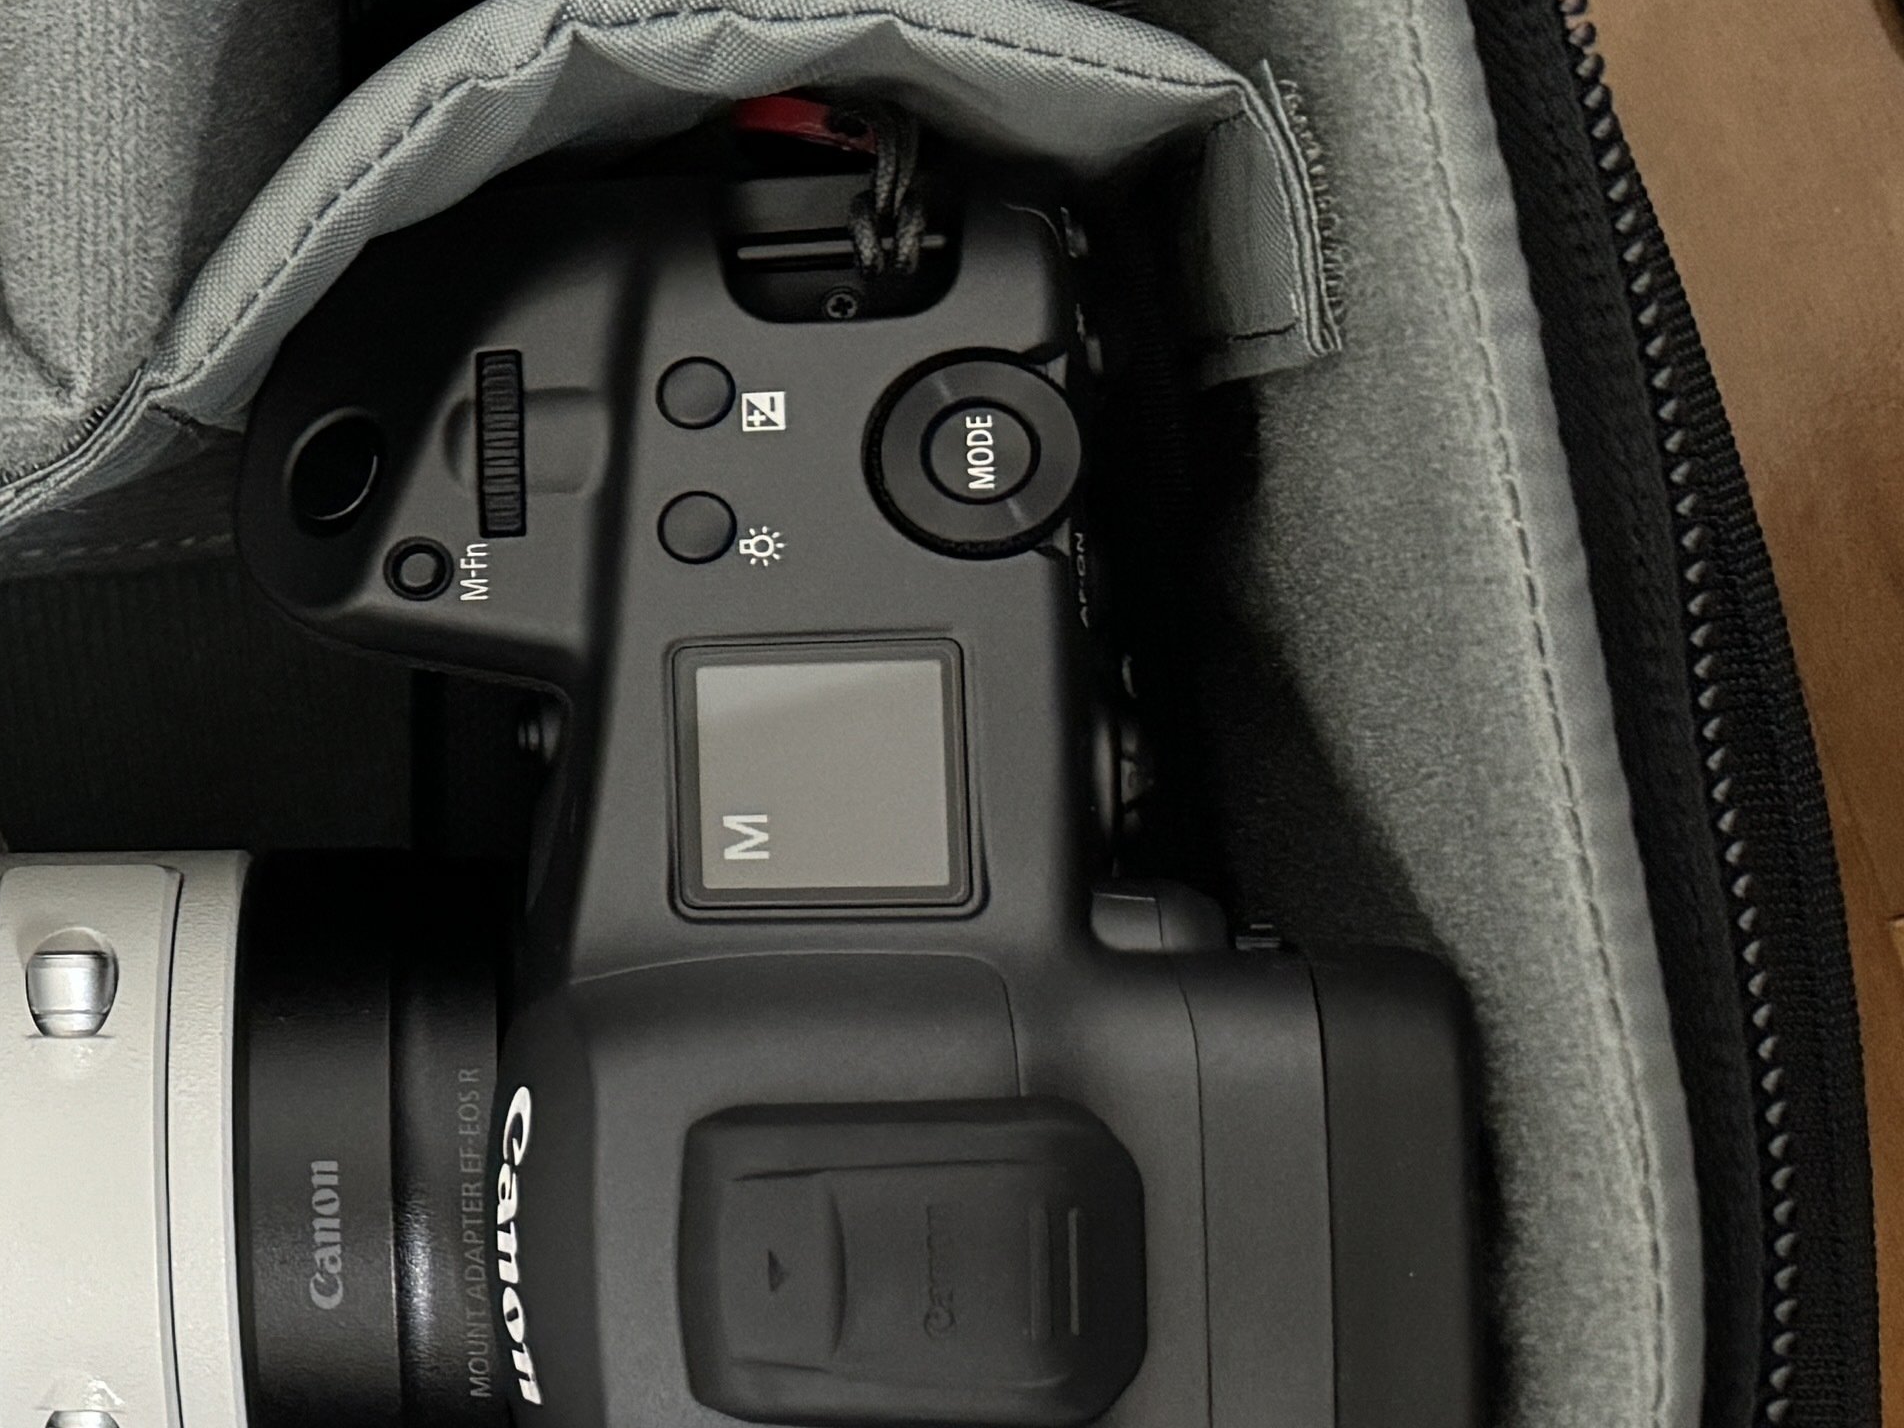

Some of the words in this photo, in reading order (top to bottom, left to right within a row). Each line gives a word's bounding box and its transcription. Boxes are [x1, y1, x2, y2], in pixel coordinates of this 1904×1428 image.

[965, 414, 996, 490] MODE
[459, 543, 489, 601] M-Fn
[722, 813, 770, 861] M
[457, 1067, 480, 1084] R
[456, 1089, 483, 1174] EF-EOS
[309, 1160, 343, 1310] Canon
[461, 1181, 487, 1302] ADAPTER
[497, 1085, 543, 1406] Canon
[467, 1307, 492, 1398] MOUNT
